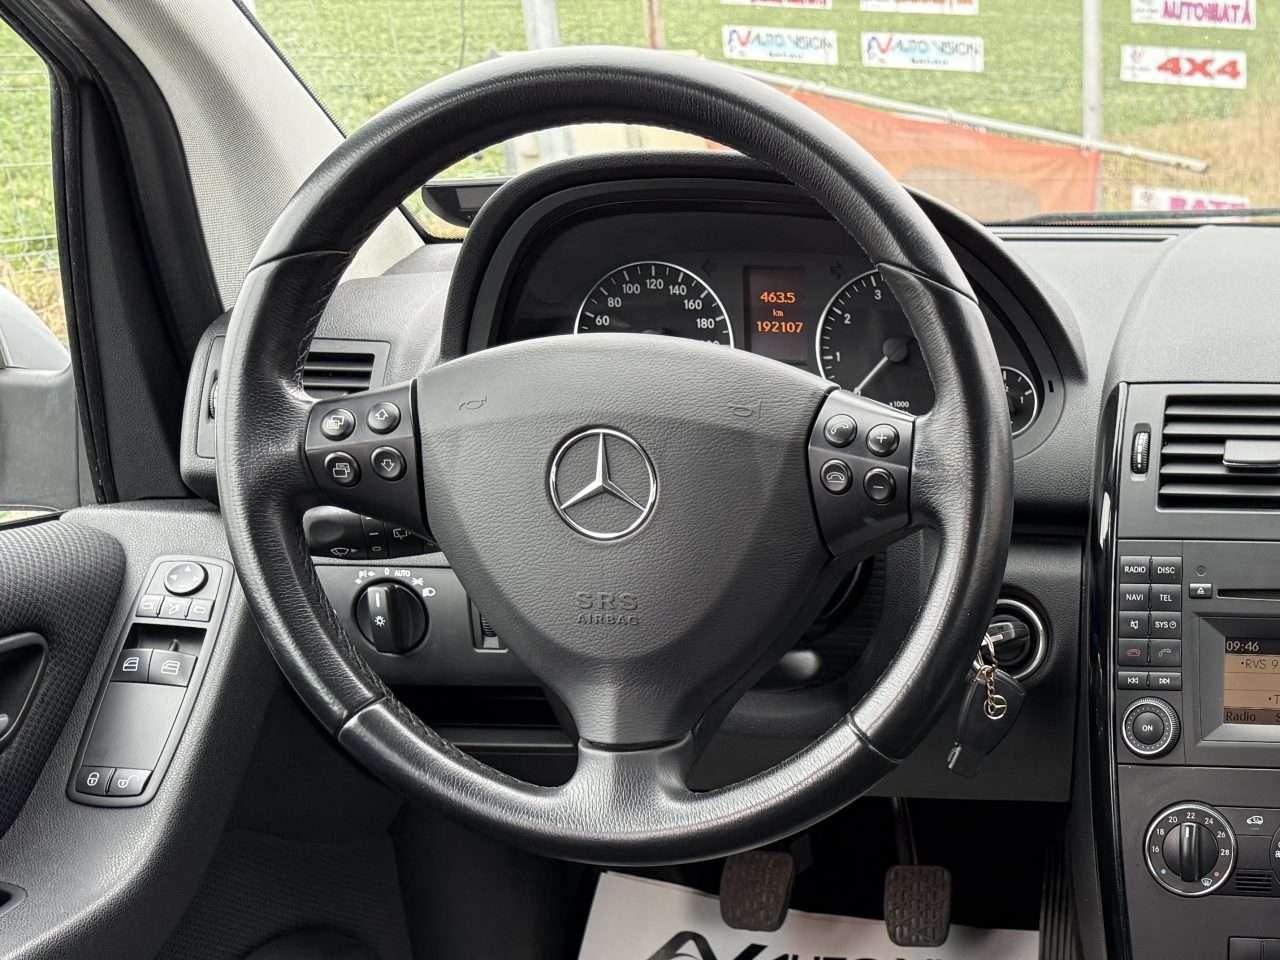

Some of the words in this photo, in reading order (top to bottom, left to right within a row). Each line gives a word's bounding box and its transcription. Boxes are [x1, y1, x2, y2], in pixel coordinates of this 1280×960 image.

[622, 284, 640, 294] 100
[646, 279, 664, 290] 120
[669, 285, 687, 295] 140
[874, 290, 881, 300] 3
[607, 297, 622, 308] 80
[760, 291, 796, 304] 463.5
[684, 300, 702, 310] 160
[773, 309, 784, 317] km
[595, 315, 610, 326] 60
[696, 318, 715, 329] 180
[844, 314, 851, 324] 2
[756, 321, 803, 333] 192107
[836, 352, 841, 362] 1
[394, 569, 411, 577] AUTO
[1124, 566, 1146, 574] RADIO
[1157, 566, 1175, 574] DISC
[576, 591, 639, 610] SRS
[1159, 594, 1172, 602] TEL
[576, 613, 639, 625] AIRBAG
[1155, 621, 1169, 629] SYS
[1226, 641, 1260, 652] 09:46
[1225, 711, 1256, 723] Radio
[1204, 817, 1214, 825] 24
[1156, 828, 1165, 836] 18
